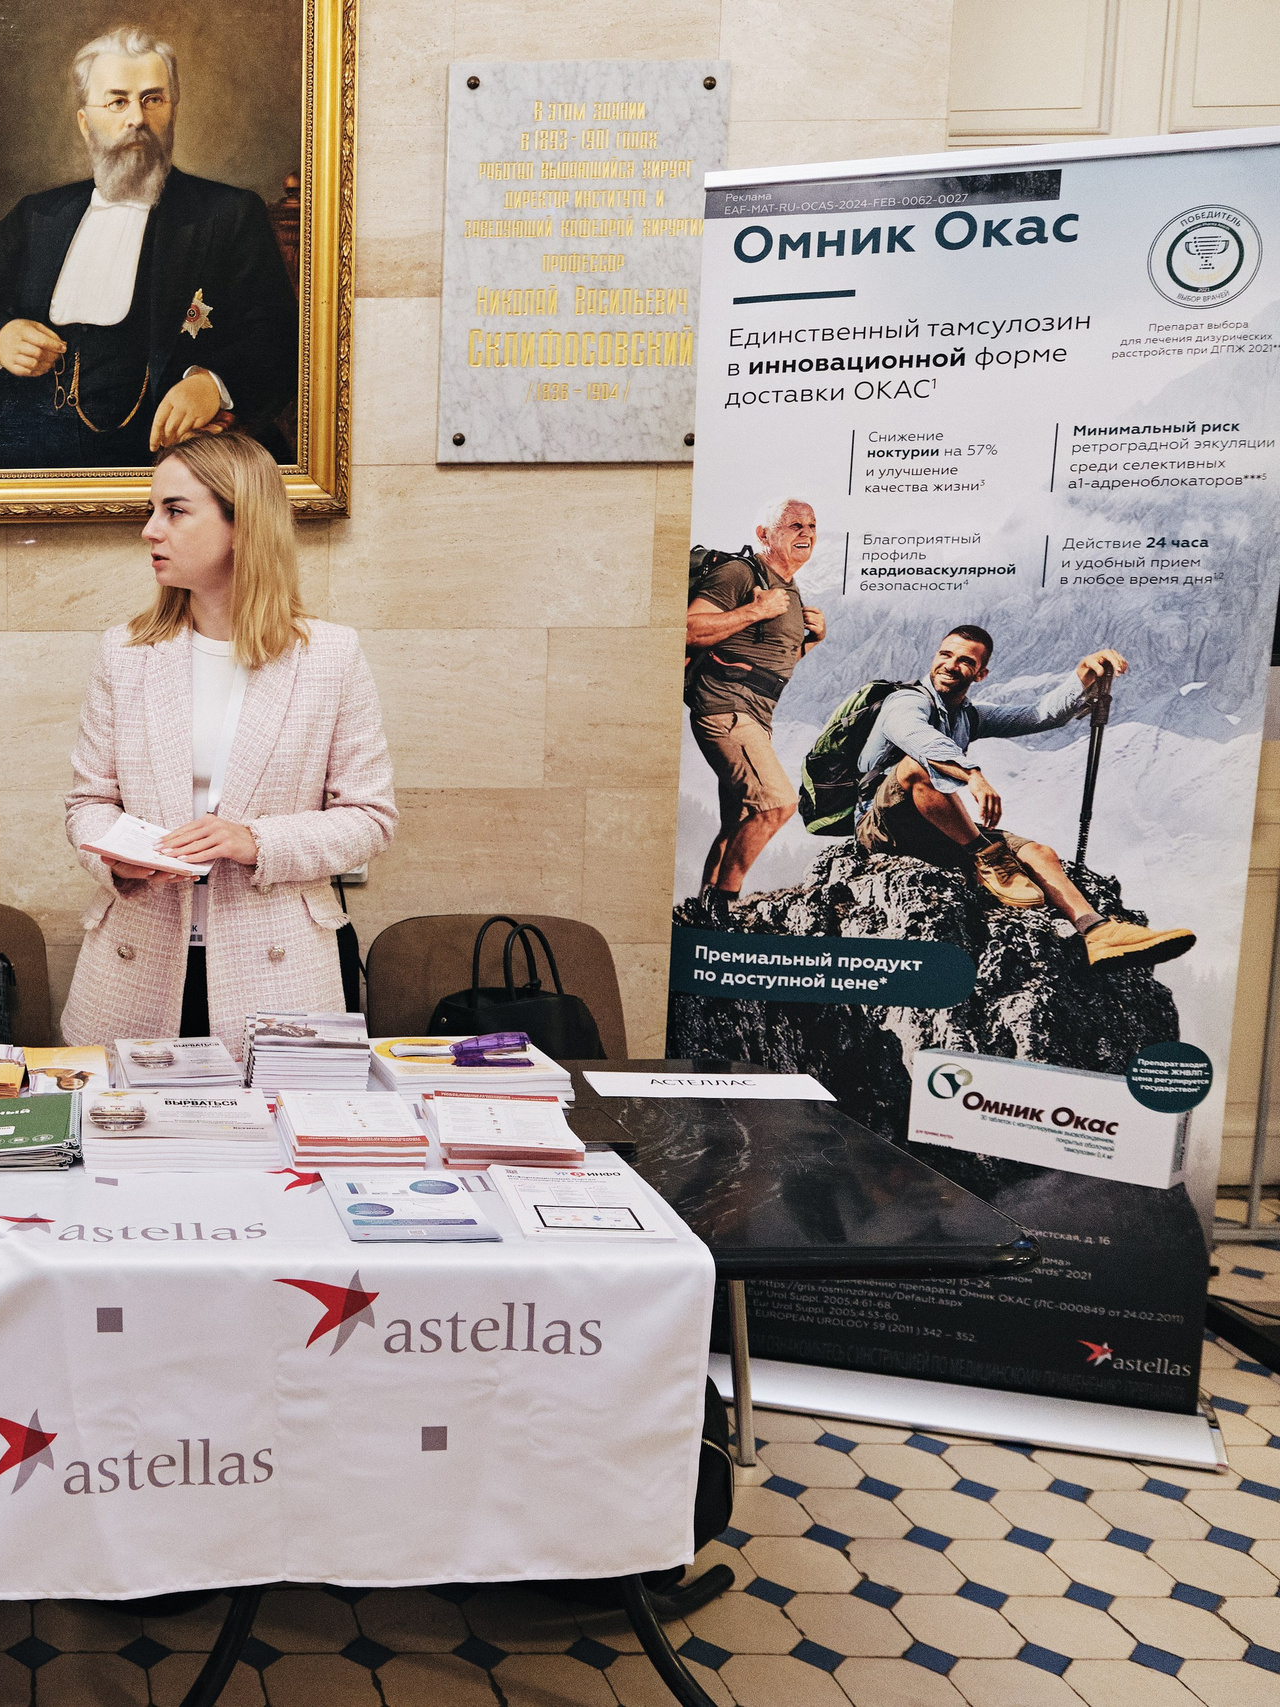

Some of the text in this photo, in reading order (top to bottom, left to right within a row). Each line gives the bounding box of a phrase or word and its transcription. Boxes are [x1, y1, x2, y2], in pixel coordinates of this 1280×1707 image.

[534, 129, 567, 150] 1893
[581, 128, 609, 150] 1901
[724, 193, 969, 215] EAF-MAT-RU-OCAS-2024-FEB-0062-0027
[725, 193, 772, 202] Реклама
[1180, 211, 1241, 228] ПОБЕДИТЕЛЬ
[733, 210, 1080, 264] Омник Окас
[1177, 290, 1230, 303] ВЫБОР ВРАЧЕЙ
[729, 314, 1091, 348] Единственный тамсулозин
[1148, 320, 1249, 333] Препарат выбора
[1120, 333, 1273, 347] для лечения дизурических
[1111, 346, 1183, 360] расстройств
[1186, 347, 1208, 356] при
[1210, 344, 1245, 355] ДГПЖ
[727, 345, 1067, 376] в инновационной форме
[724, 386, 845, 409] доставки
[868, 431, 944, 442] Снижение
[1073, 421, 1240, 437] Минимальный риск
[867, 443, 998, 460] ноктурии на 57%
[1071, 438, 1275, 455] ретроградной эякуляции
[865, 466, 958, 479] и улучшение
[1070, 459, 1226, 474] среди селективных
[864, 482, 928, 493] качества
[863, 533, 981, 547] Благоприятный
[1062, 537, 1209, 551] Действие 24 часа
[862, 550, 927, 563] профиль
[1061, 556, 1201, 570] и удобный прием
[860, 563, 1016, 578] кардиоваскулярной
[1060, 576, 1068, 585] в
[1073, 574, 1124, 585] любое
[1129, 575, 1179, 587] время
[695, 944, 923, 974] Премиальный продукт
[693, 968, 717, 981] по
[720, 971, 826, 990] доступной
[1137, 1058, 1179, 1068] Препарат
[650, 1078, 757, 1086] АСТЕЛЛАС
[1154, 1077, 1210, 1086] регулируется
[962, 1090, 1046, 1123] Омник
[1050, 1106, 1119, 1136] Окас
[58, 1221, 268, 1244] astellas
[384, 1302, 603, 1356] astellas
[1113, 1357, 1192, 1377] astellas
[63, 1438, 274, 1495] astellas
